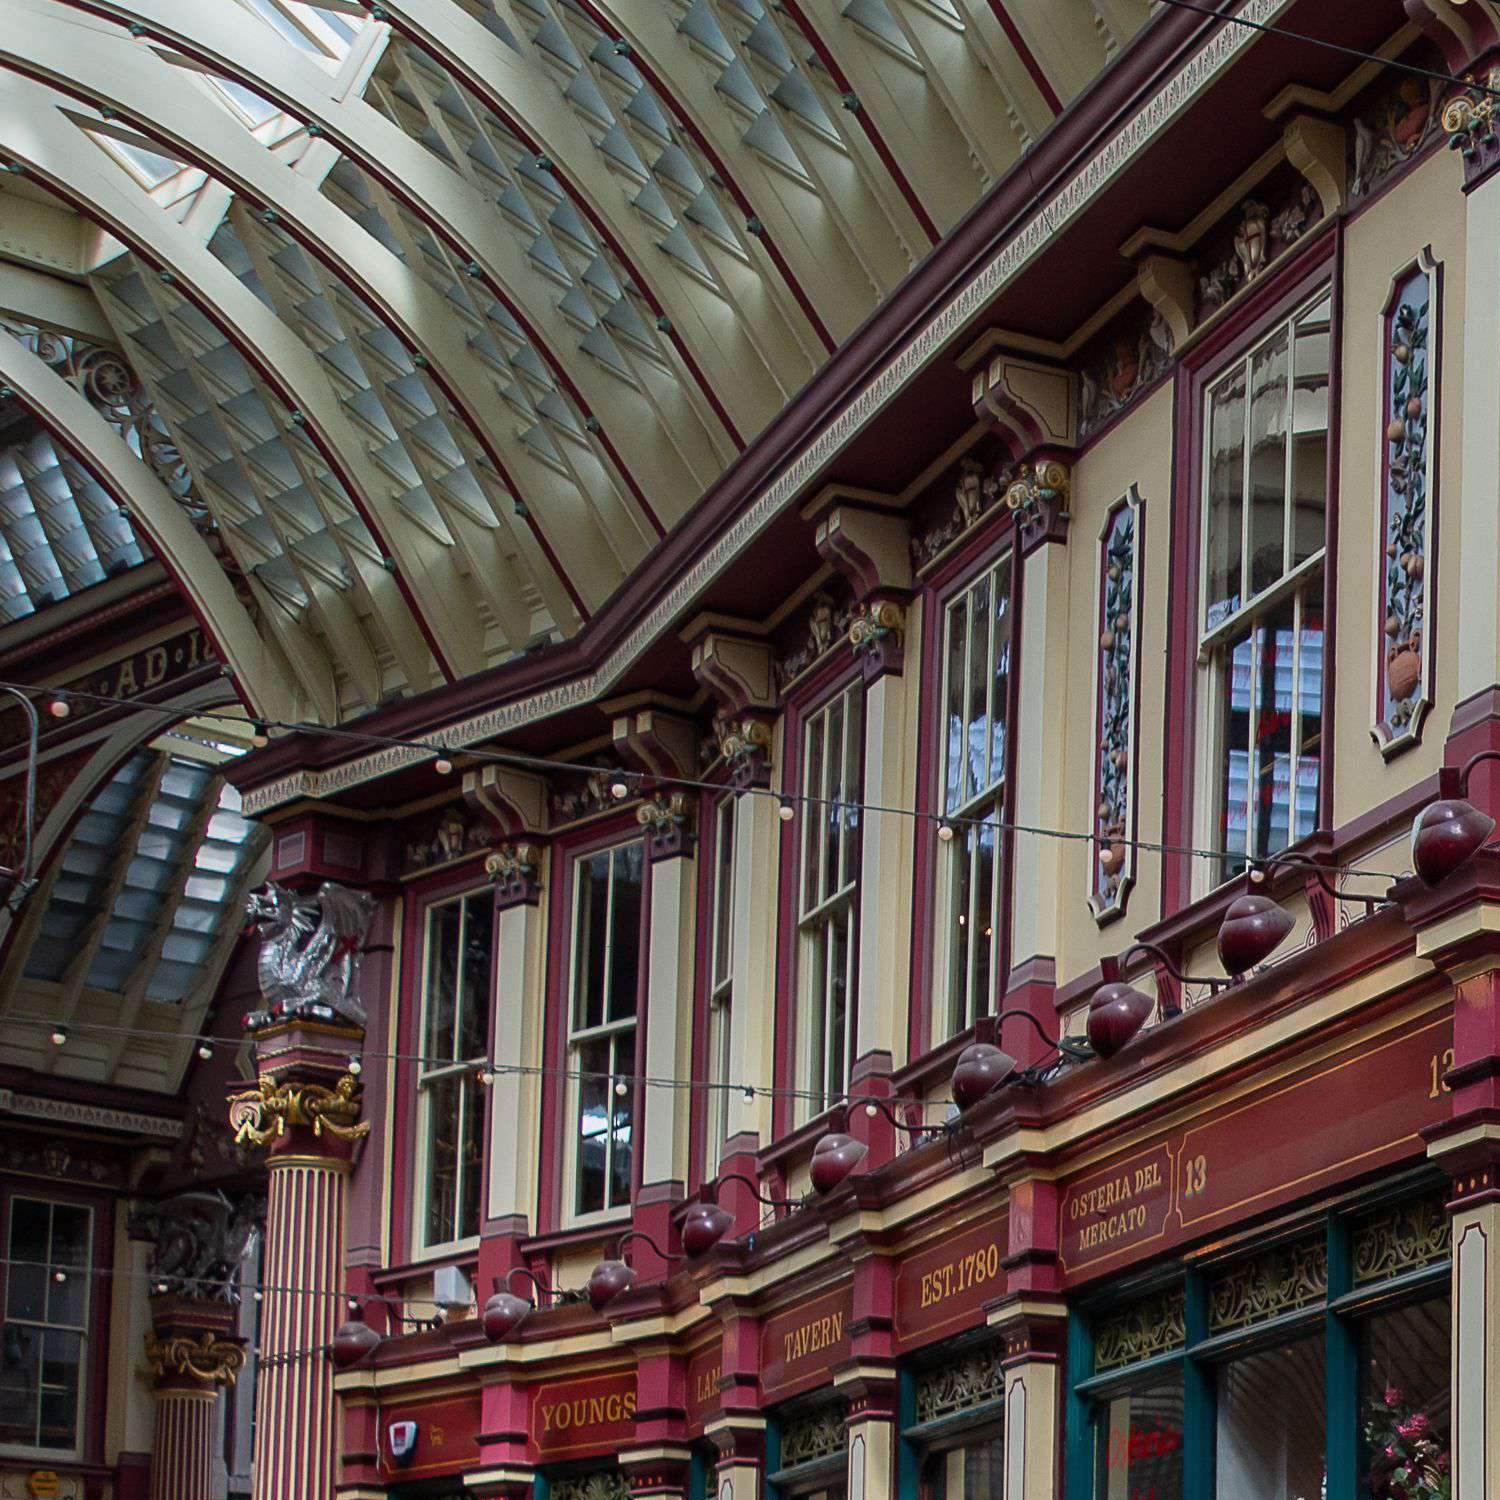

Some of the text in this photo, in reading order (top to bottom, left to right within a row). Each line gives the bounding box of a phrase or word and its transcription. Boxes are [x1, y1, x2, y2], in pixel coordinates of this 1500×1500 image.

[1070, 1162, 1162, 1220] OSTERIA DEL
[1185, 1154, 1207, 1199] 13
[1079, 1204, 1147, 1251] MERCATO
[784, 1311, 843, 1363] TAVERN
[696, 1366, 721, 1403] LAM
[541, 1391, 637, 1432] YOUNGS
